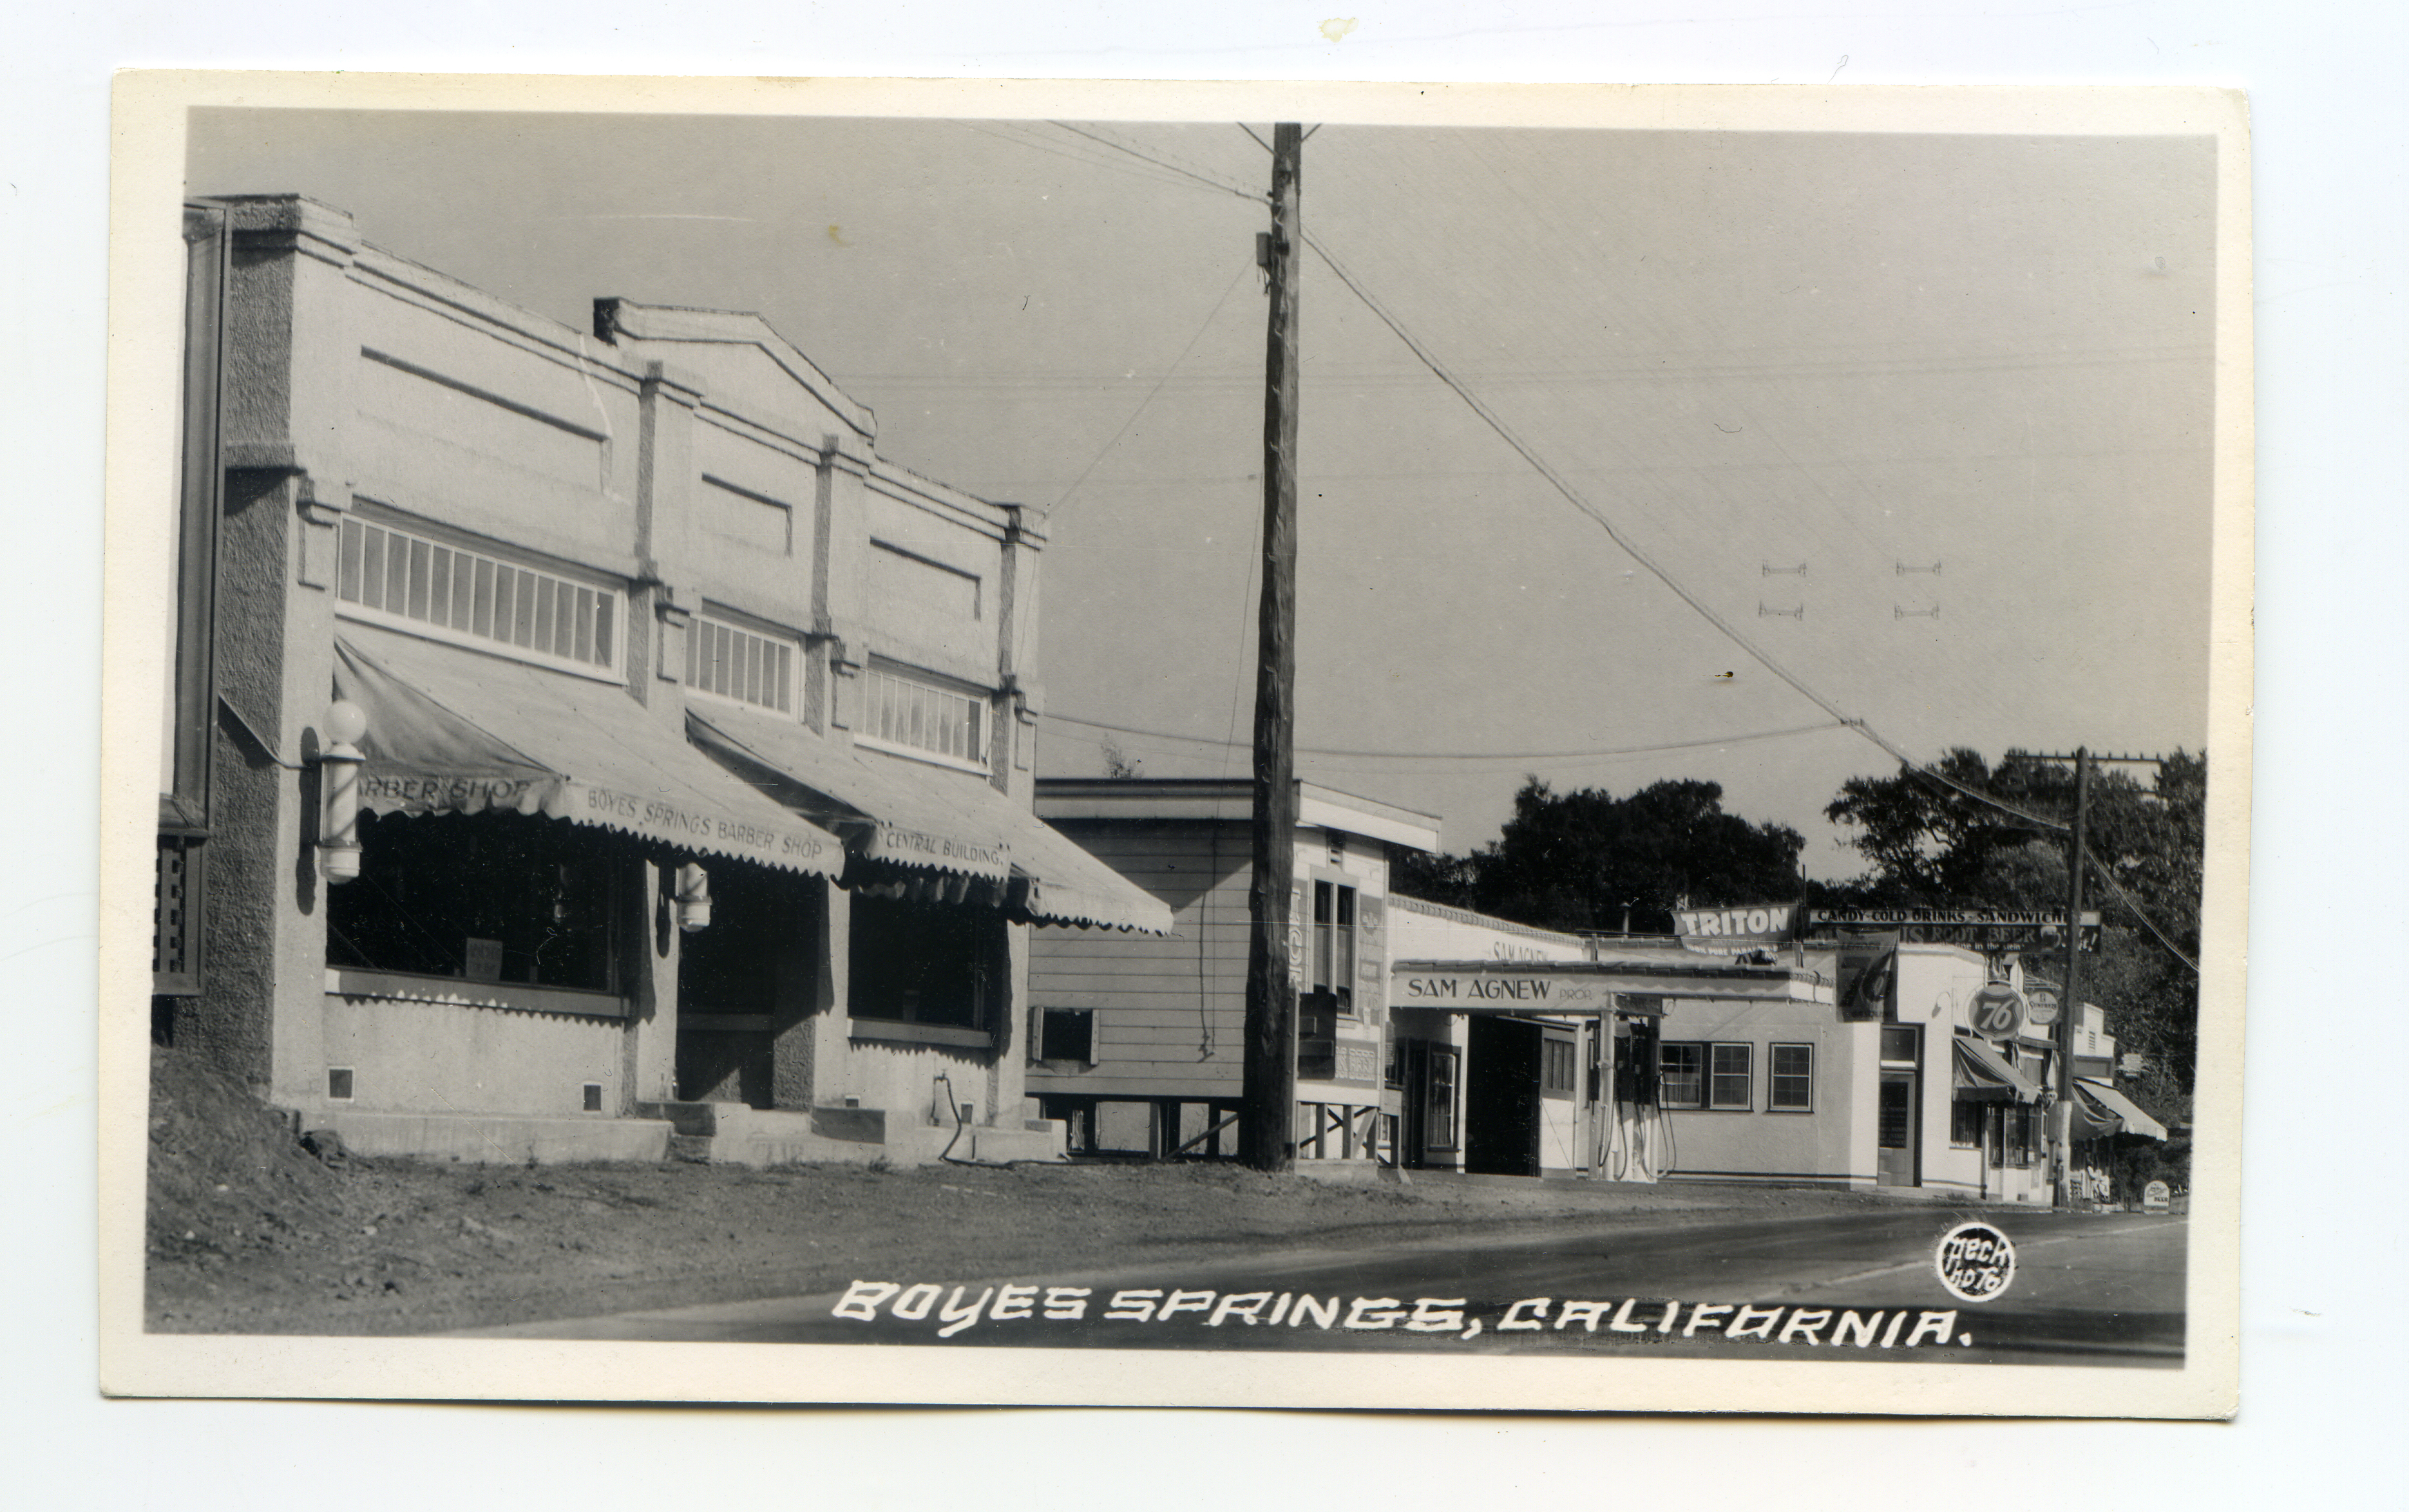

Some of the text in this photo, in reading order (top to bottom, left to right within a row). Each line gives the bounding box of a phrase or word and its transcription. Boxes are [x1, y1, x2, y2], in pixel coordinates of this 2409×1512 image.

[452, 779, 530, 799] SHOP
[588, 789, 822, 859] BOYES SPRINGS BARBER SHOP
[886, 832, 936, 855] CENTRAL
[1681, 907, 1789, 936] TRITON
[1912, 911, 1965, 922] DRINKS
[1932, 926, 1977, 942] ROOT
[1987, 927, 2036, 943] BEER
[1708, 946, 1729, 956] PURE
[1974, 942, 1983, 950] in
[1408, 979, 1457, 998] SAM
[1467, 979, 1551, 999] AGNEW
[1980, 999, 2015, 1030] 76
